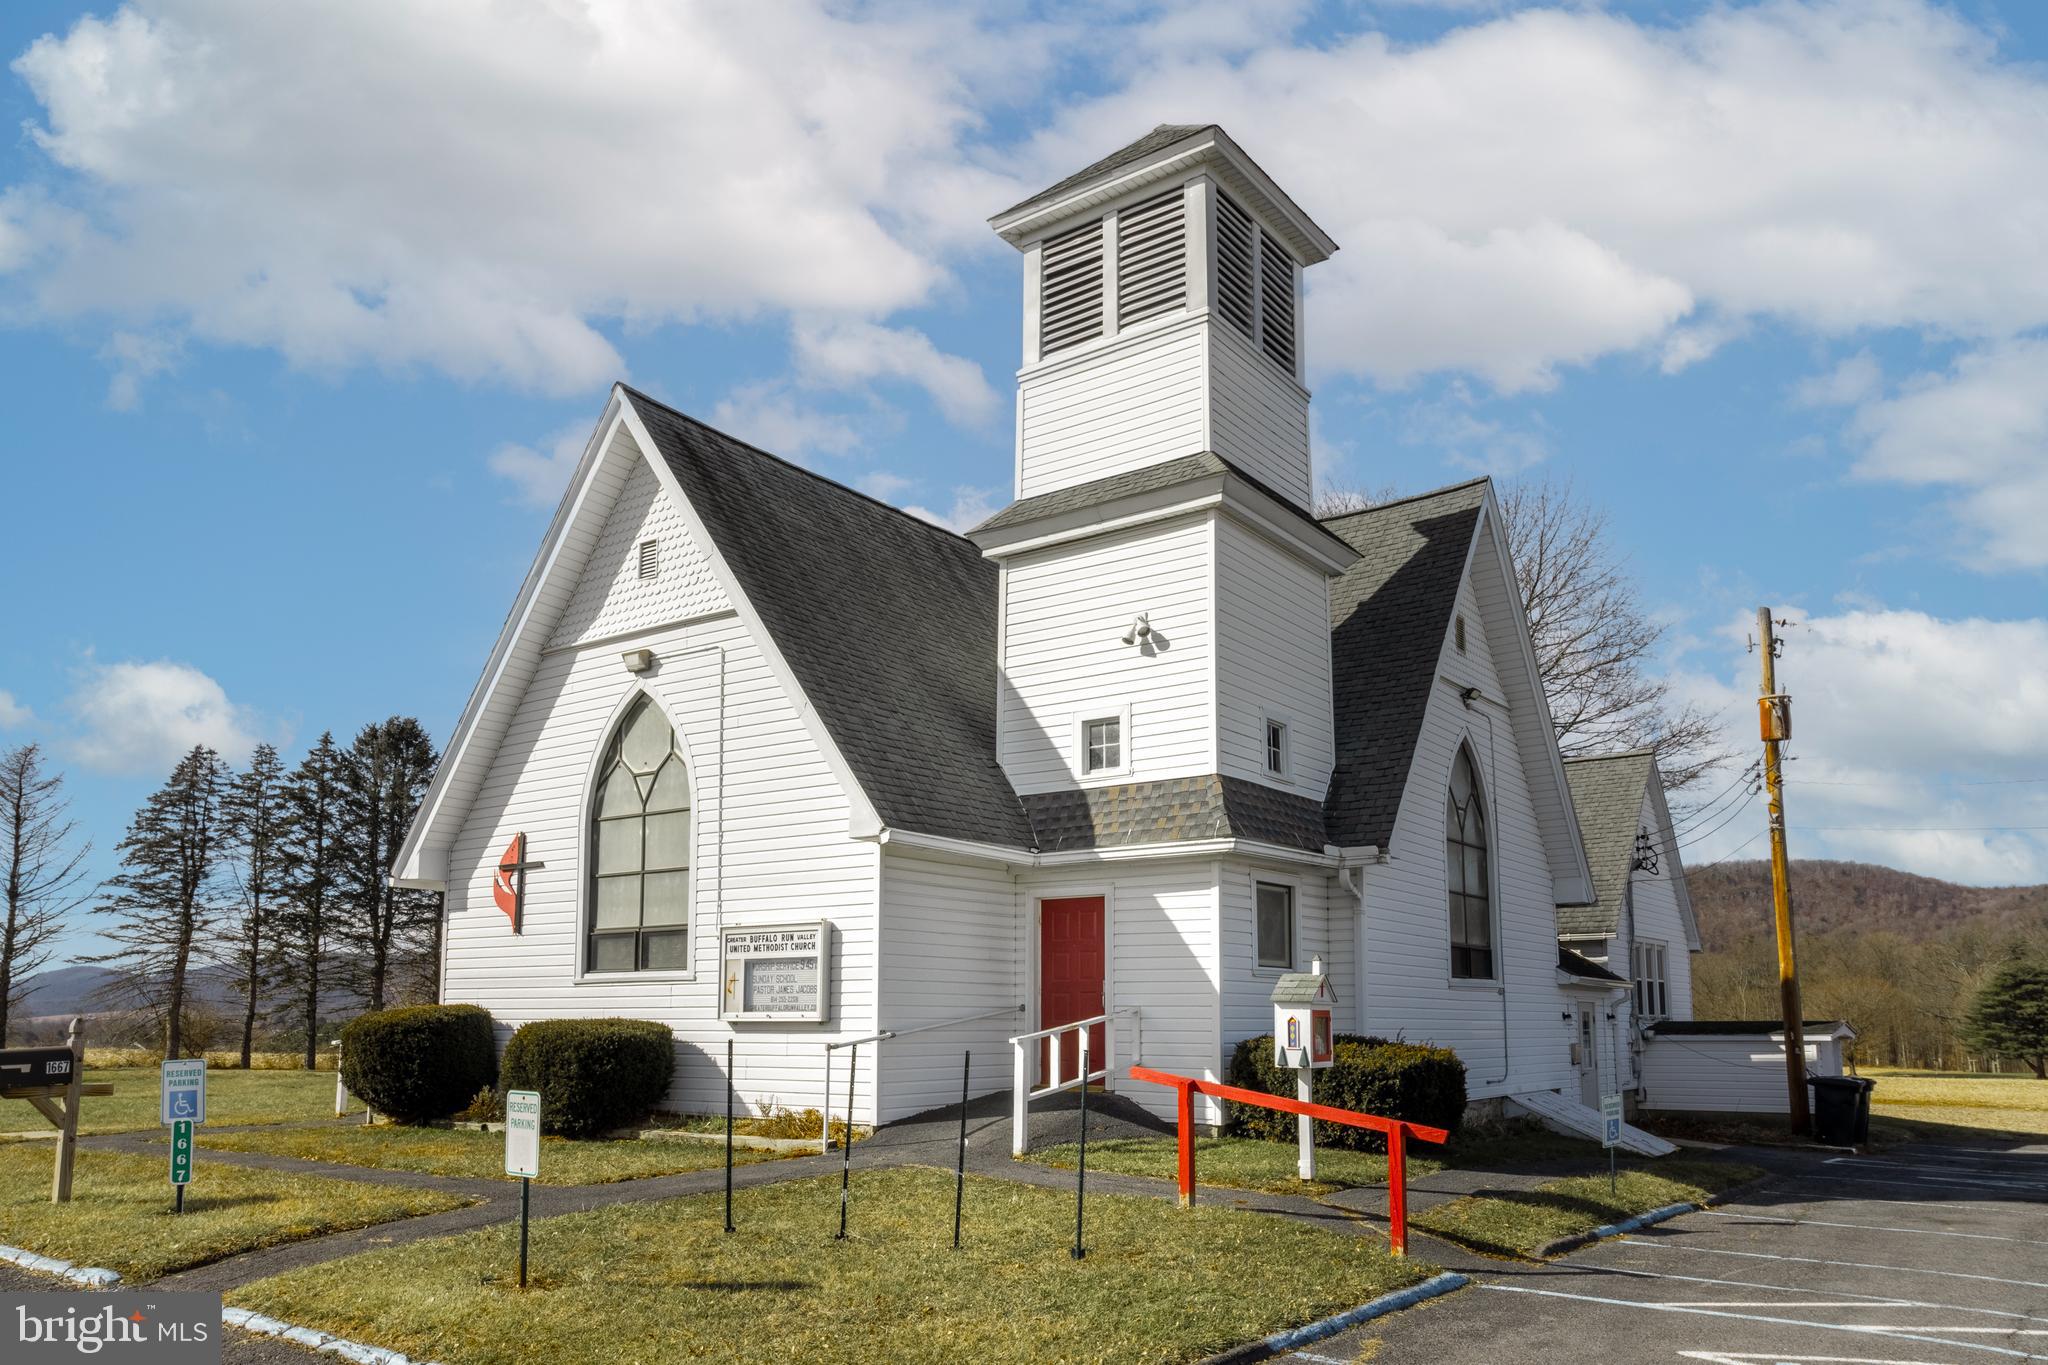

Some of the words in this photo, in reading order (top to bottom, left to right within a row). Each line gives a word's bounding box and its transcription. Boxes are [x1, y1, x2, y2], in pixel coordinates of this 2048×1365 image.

[750, 934, 778, 943] BUFFALO
[782, 933, 794, 942] RUN
[730, 944, 751, 953] UNITED
[753, 943, 788, 952] METHODIST
[790, 942, 816, 951] CHURCH
[752, 975, 773, 984] SUNDAY
[775, 974, 798, 984] SCHOOL
[753, 986, 774, 995] PASTOR
[776, 985, 795, 994] JAMES
[796, 984, 817, 994] JACOBS
[47, 1062, 69, 1073] 1667
[510, 1102, 538, 1113] RESERVED
[510, 1118, 535, 1130] PARKING
[176, 1120, 187, 1182] 1667
